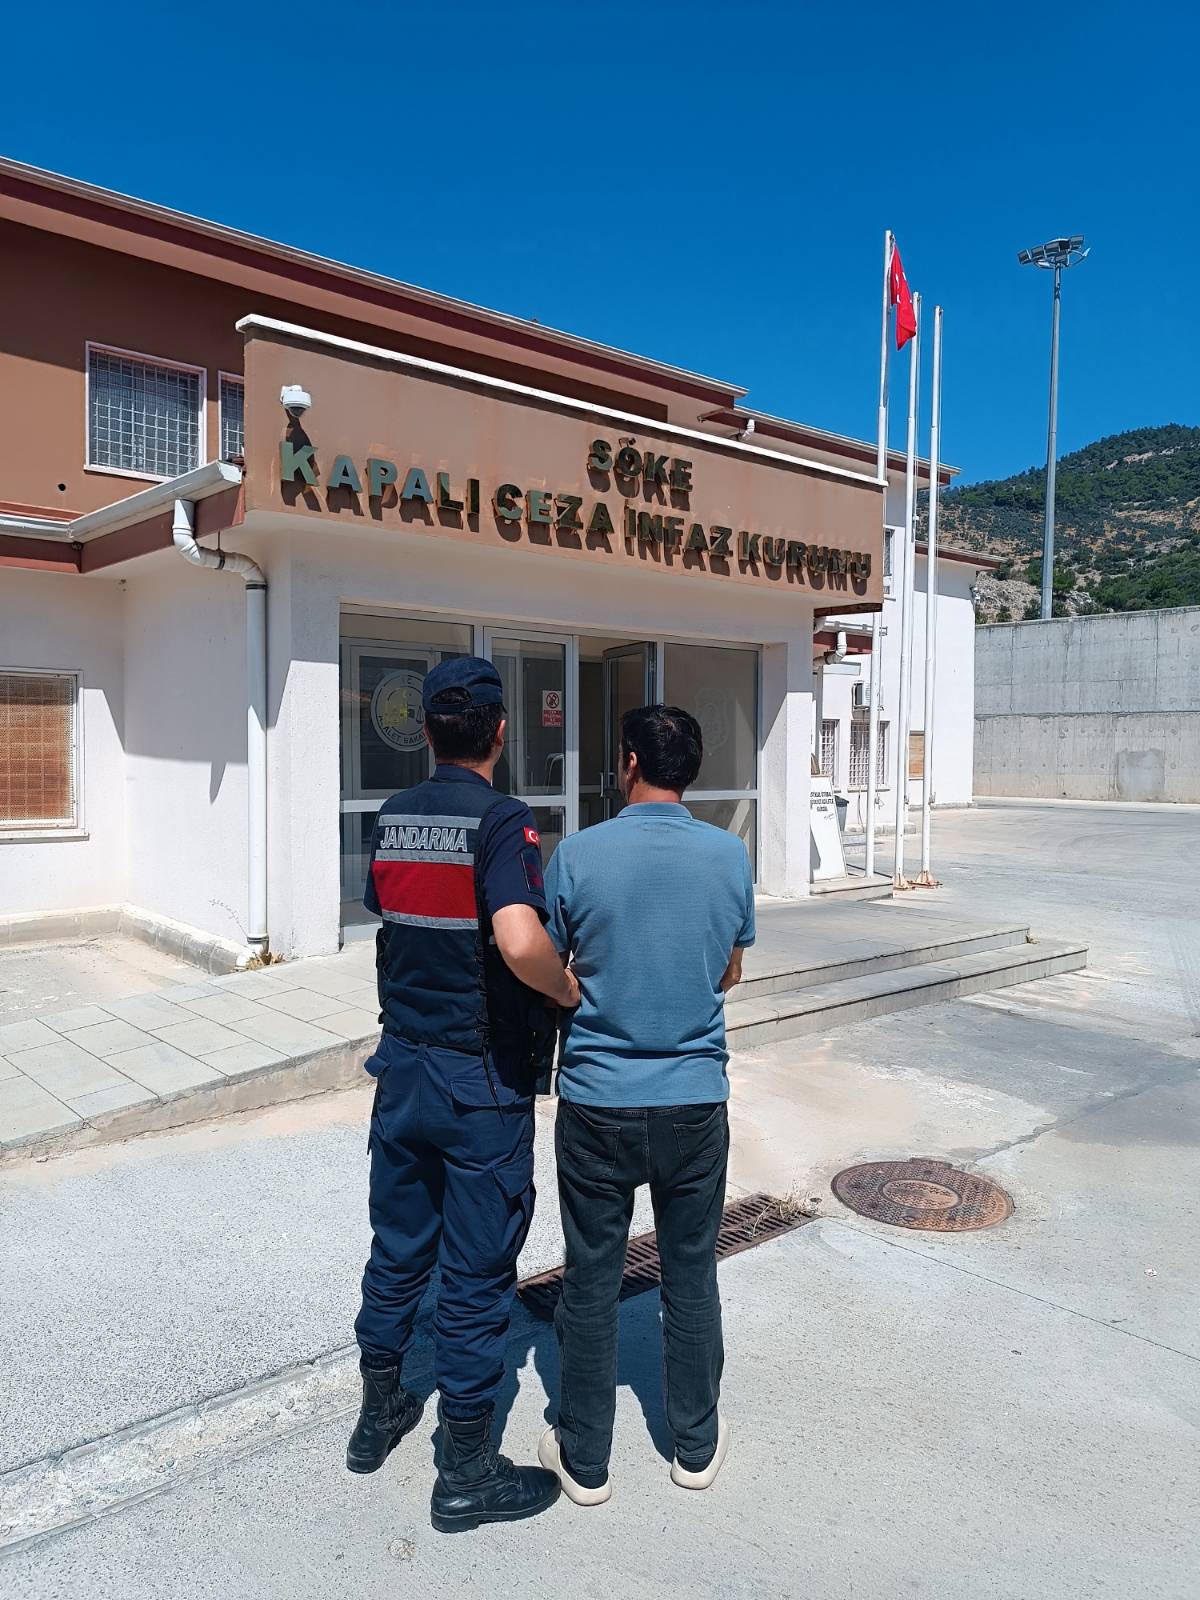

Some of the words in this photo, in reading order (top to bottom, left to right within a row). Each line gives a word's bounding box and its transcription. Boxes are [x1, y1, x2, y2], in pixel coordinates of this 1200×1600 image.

[279, 441, 480, 514] KAPALI
[738, 530, 872, 580] KURUMU
[380, 826, 469, 853] JANDARMA
